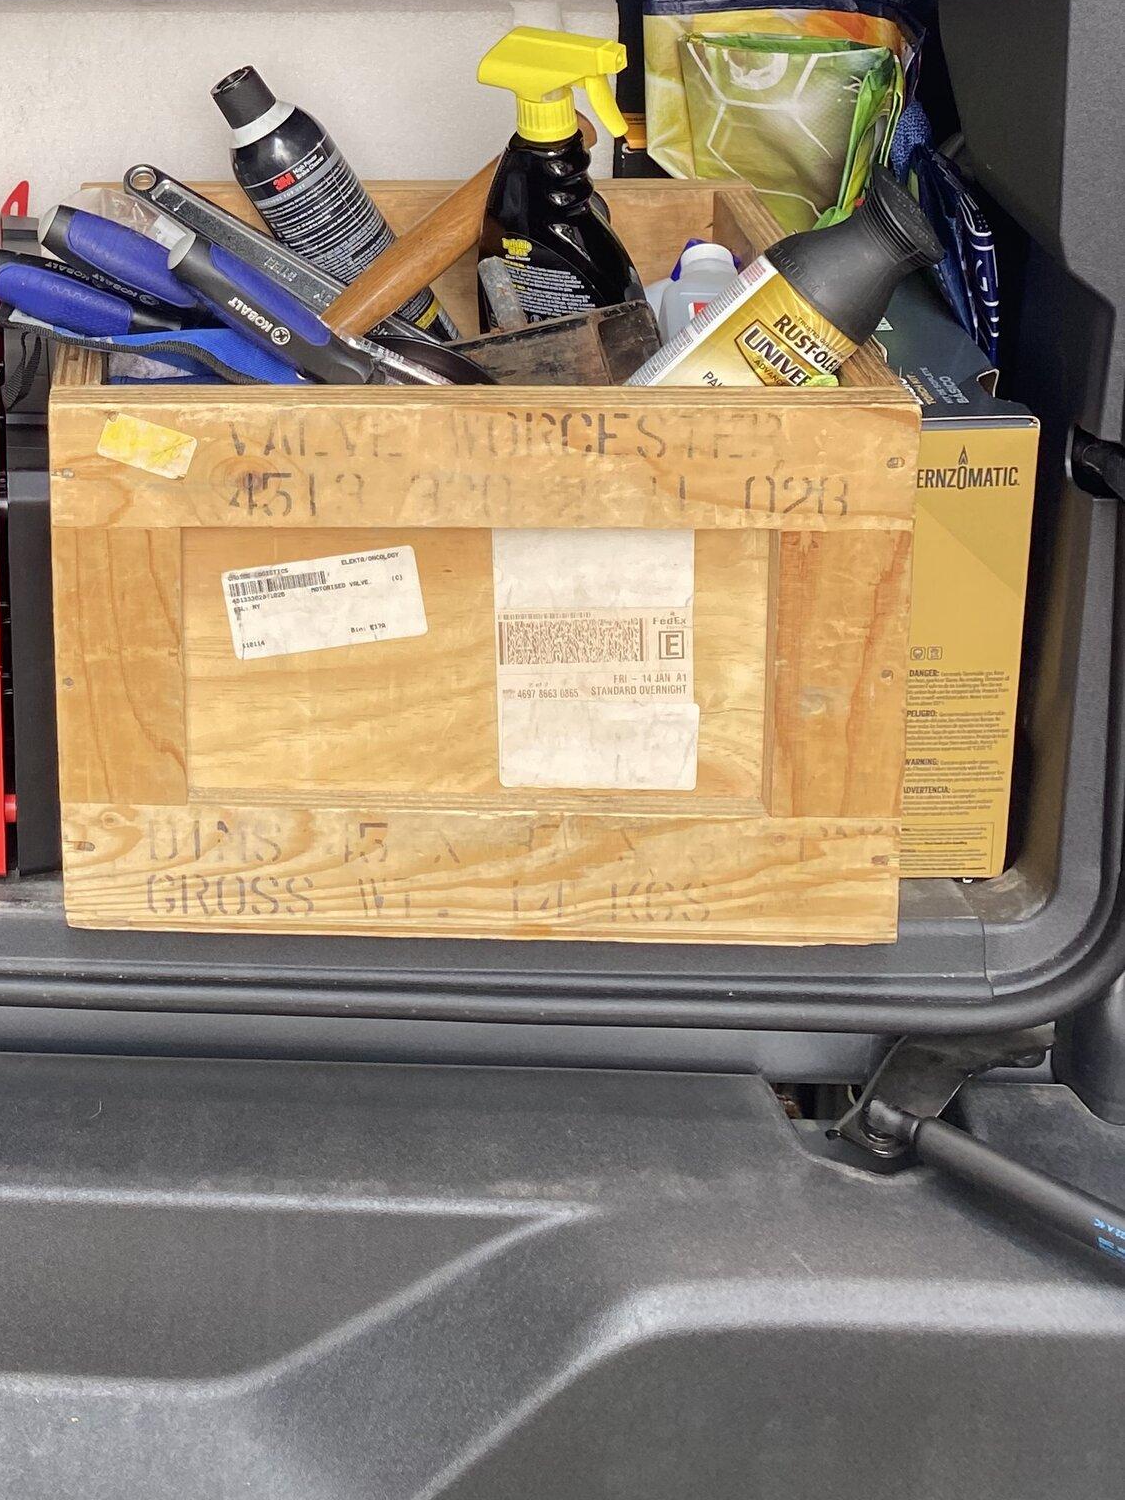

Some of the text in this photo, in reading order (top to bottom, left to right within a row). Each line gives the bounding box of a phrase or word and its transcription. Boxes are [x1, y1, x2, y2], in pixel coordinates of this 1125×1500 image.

[272, 172, 295, 192] 3M
[45, 261, 90, 282] KOBALT
[92, 273, 138, 298] KOBALT
[228, 297, 274, 333] KOBALT
[227, 412, 402, 457] VALVE
[916, 464, 1020, 490] ERNZOMATIC
[652, 616, 687, 626] FedEx
[665, 633, 680, 657] E
[613, 673, 628, 684] FRI
[654, 673, 671, 683] JAN
[908, 669, 940, 678] DANGER:
[517, 688, 537, 699] 4697
[590, 684, 687, 697] STANDARD OVERNIGHT
[146, 873, 315, 916] GROSS
